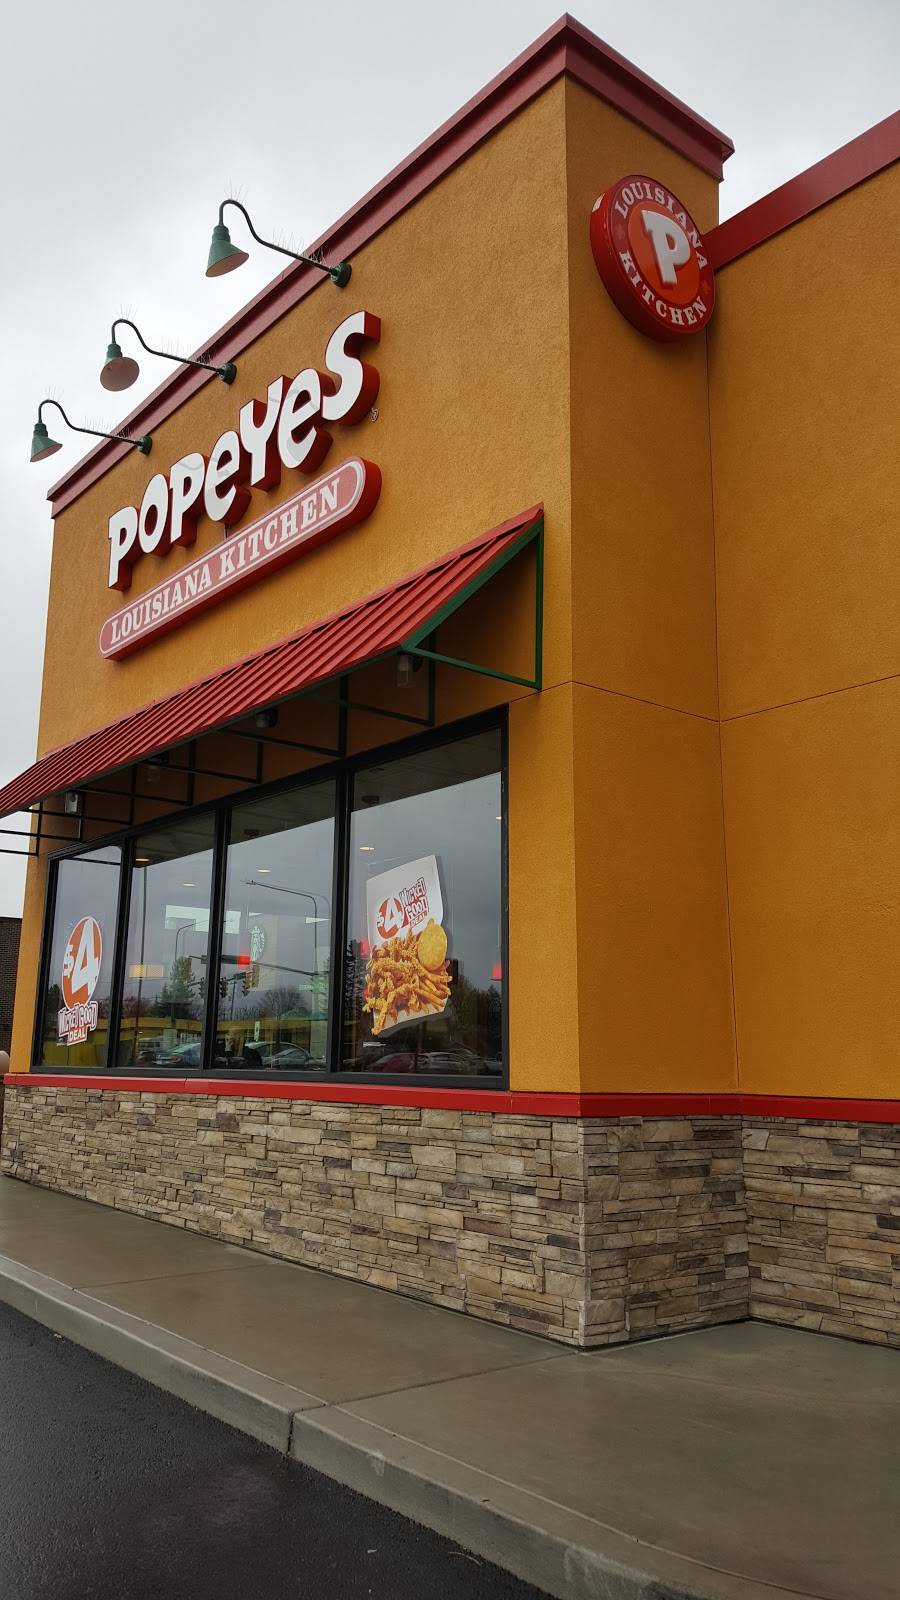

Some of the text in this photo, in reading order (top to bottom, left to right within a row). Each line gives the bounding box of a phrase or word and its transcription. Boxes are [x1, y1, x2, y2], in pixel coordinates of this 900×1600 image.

[614, 181, 708, 270] LOUISIANA
[641, 210, 691, 284] P
[619, 250, 707, 326] KITCHEN
[110, 478, 341, 645] LOUISIANA KITCHEN
[405, 896, 429, 919] GOOD
[68, 1028, 87, 1043] DEAL
[79, 1001, 98, 1031] GOOD
